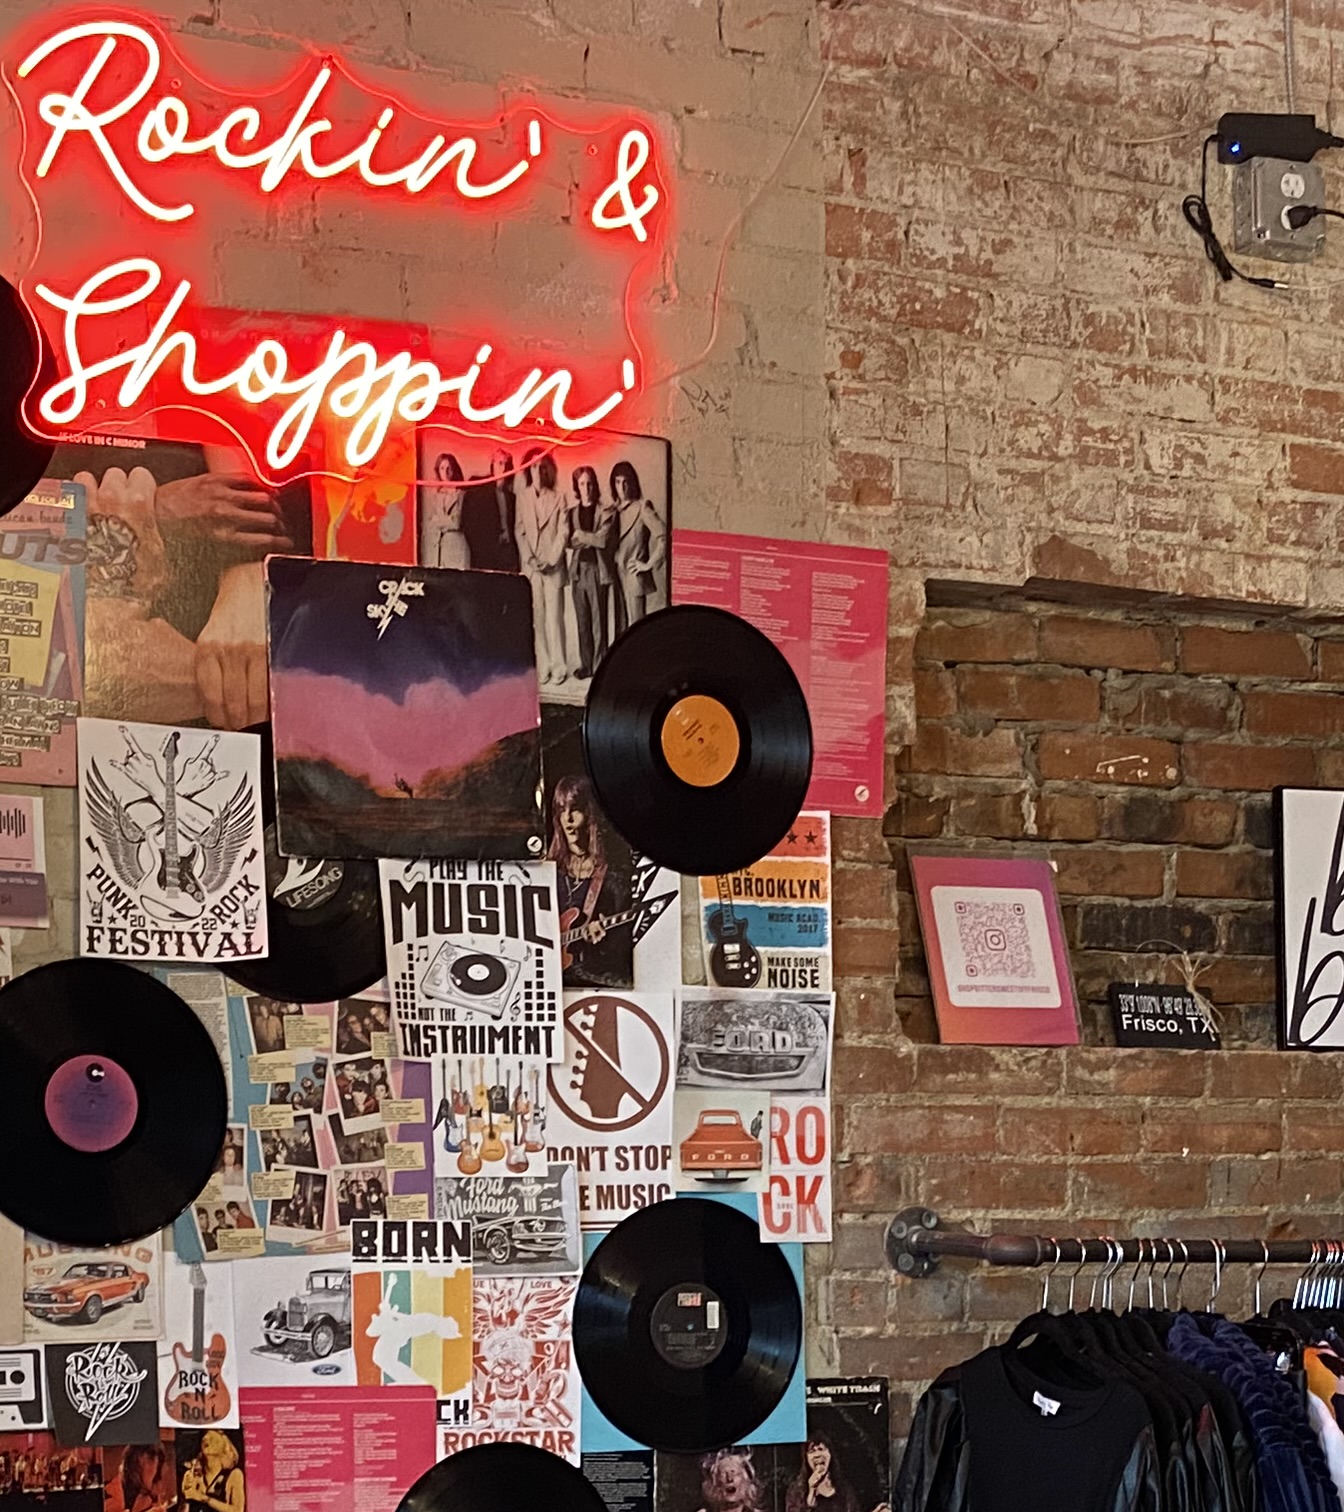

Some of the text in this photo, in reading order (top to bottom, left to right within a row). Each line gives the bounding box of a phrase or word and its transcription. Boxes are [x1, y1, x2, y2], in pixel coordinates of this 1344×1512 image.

[17, 21, 659, 243] Rockin' &
[35, 258, 635, 470] Shoppin'
[429, 860, 505, 882] PLAY THE
[85, 862, 139, 921] PUNK
[208, 873, 261, 925] ROCK
[731, 876, 821, 900] BROOKLYN
[129, 914, 146, 928] 20
[201, 917, 218, 931] 22
[389, 879, 555, 950] MUSIC
[85, 924, 264, 959] FESTIVAL
[767, 956, 820, 968] MAKE SOME
[767, 968, 820, 989] NOISE
[417, 1007, 457, 1022] NOT THE
[1121, 1013, 1214, 1036] Frisco, TX
[399, 1023, 556, 1059] INSTRUMENT
[711, 1028, 795, 1055] FORD
[546, 1144, 672, 1172] DON'T STOP
[691, 1153, 750, 1162] FORD
[459, 1176, 507, 1199] Ford
[596, 1183, 672, 1211] MUSIC
[445, 1192, 520, 1220] Mustang
[351, 1220, 472, 1263] BORN
[530, 1281, 552, 1289] LOVE
[65, 1350, 149, 1384] Rock
[177, 1370, 220, 1391] ROCK
[194, 1386, 206, 1403] N
[180, 1401, 220, 1421] ROLL
[435, 1399, 470, 1426] CK
